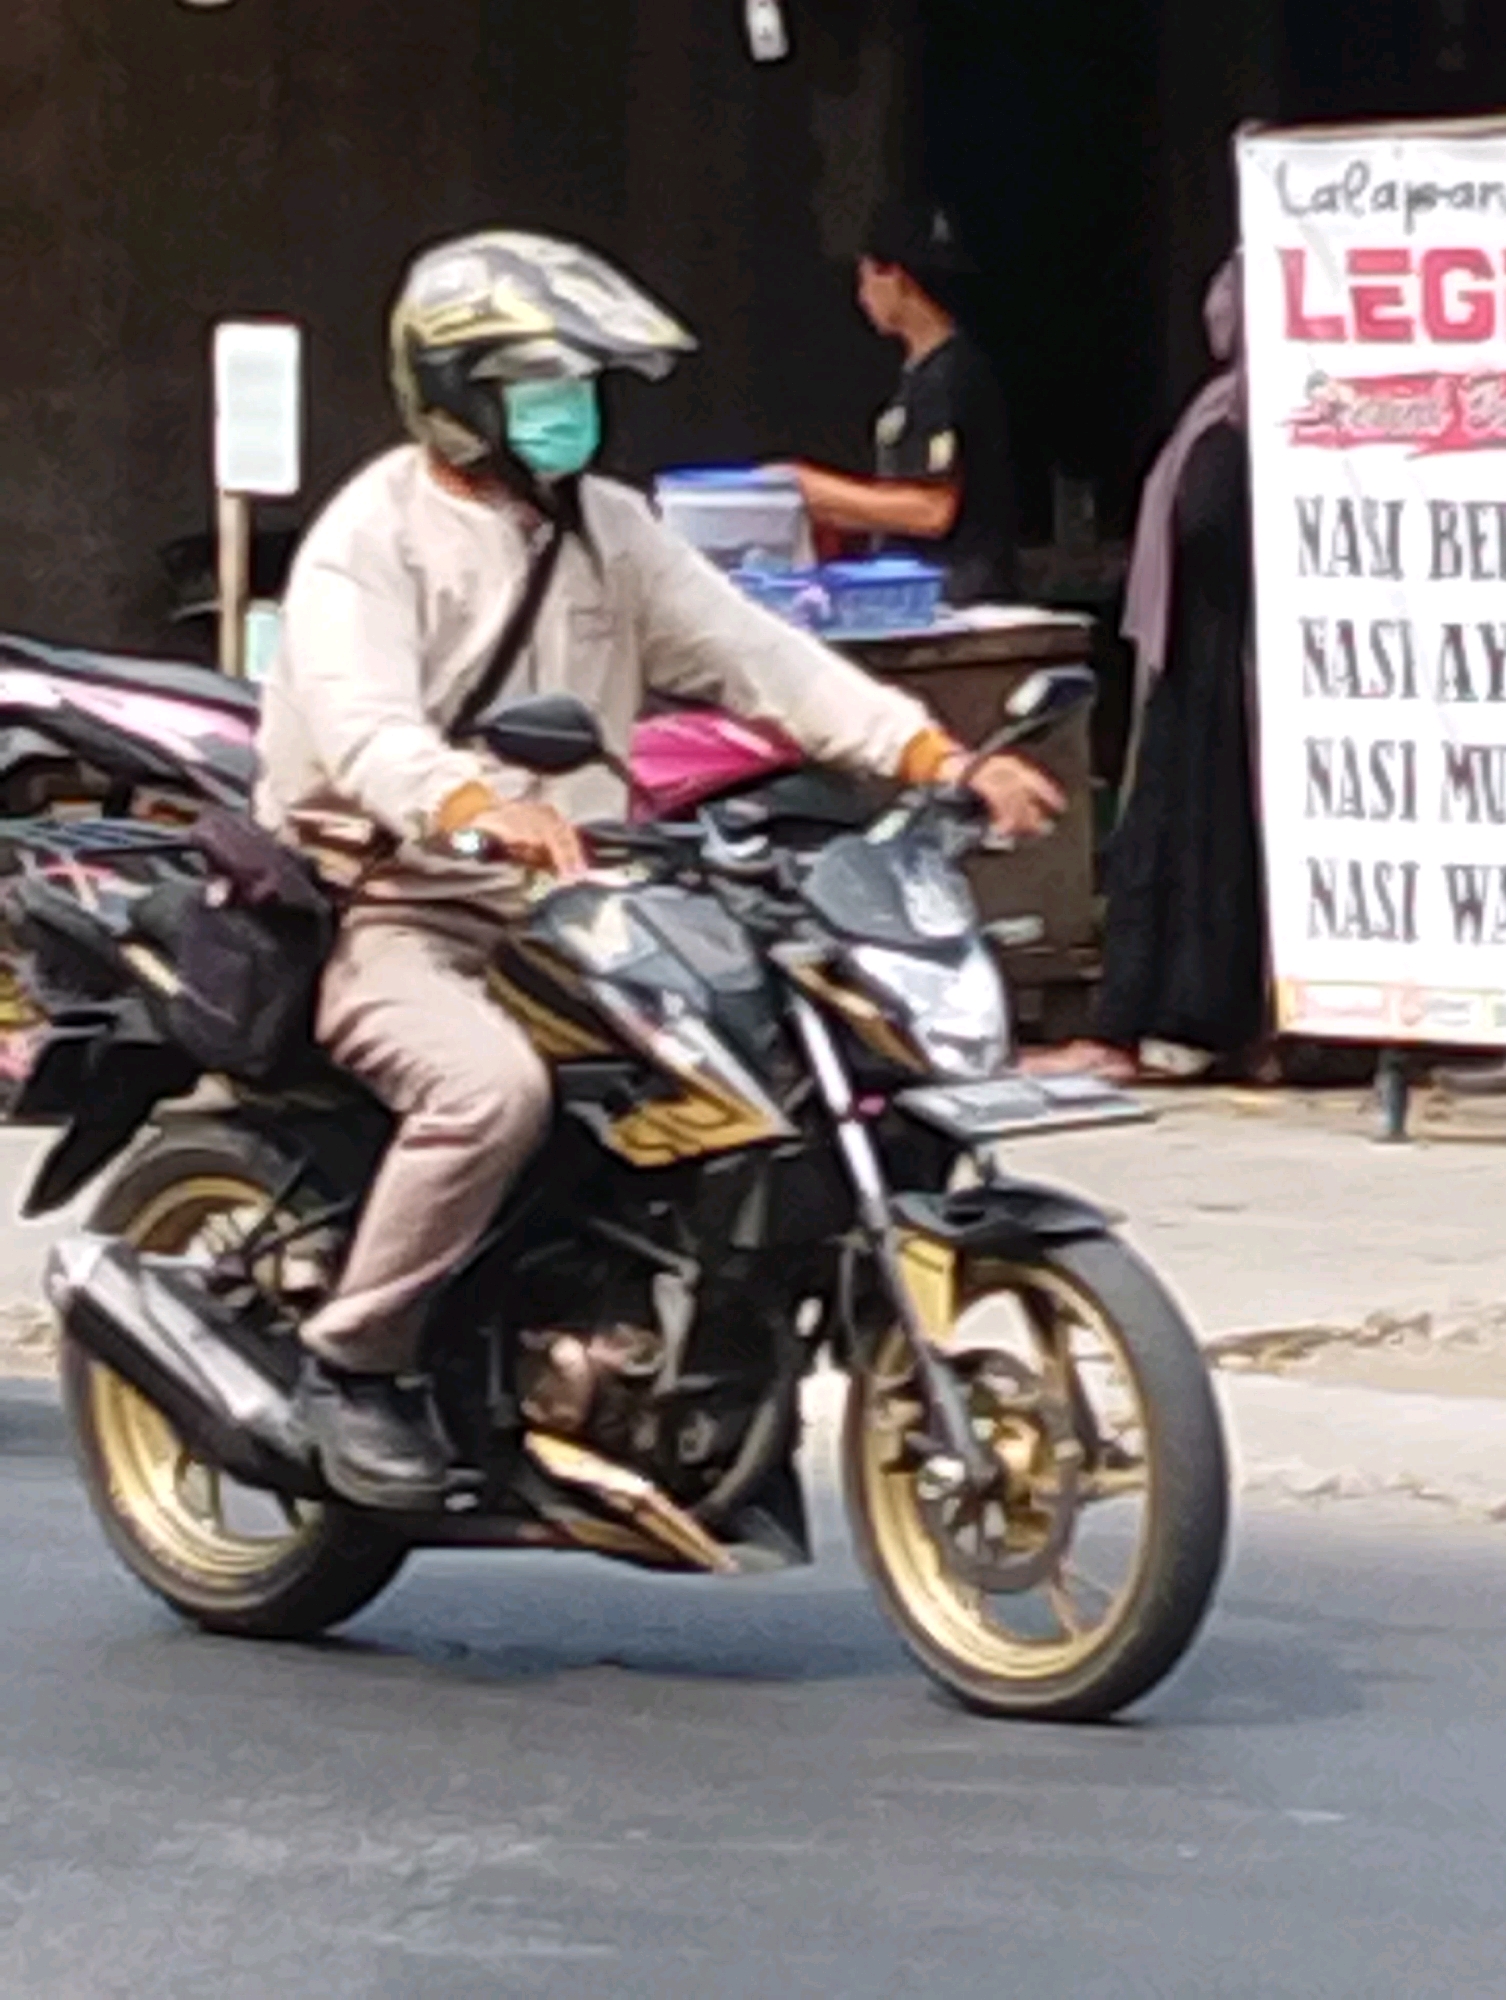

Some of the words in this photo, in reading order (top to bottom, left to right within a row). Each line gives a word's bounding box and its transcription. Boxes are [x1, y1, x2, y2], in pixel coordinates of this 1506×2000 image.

[1276, 246, 1506, 343] LEG
[1296, 495, 1405, 579] NASI
[1426, 498, 1506, 581] BE
[1299, 616, 1418, 700] NASI
[1304, 736, 1417, 822] NASI
[1307, 858, 1420, 942] NASI
